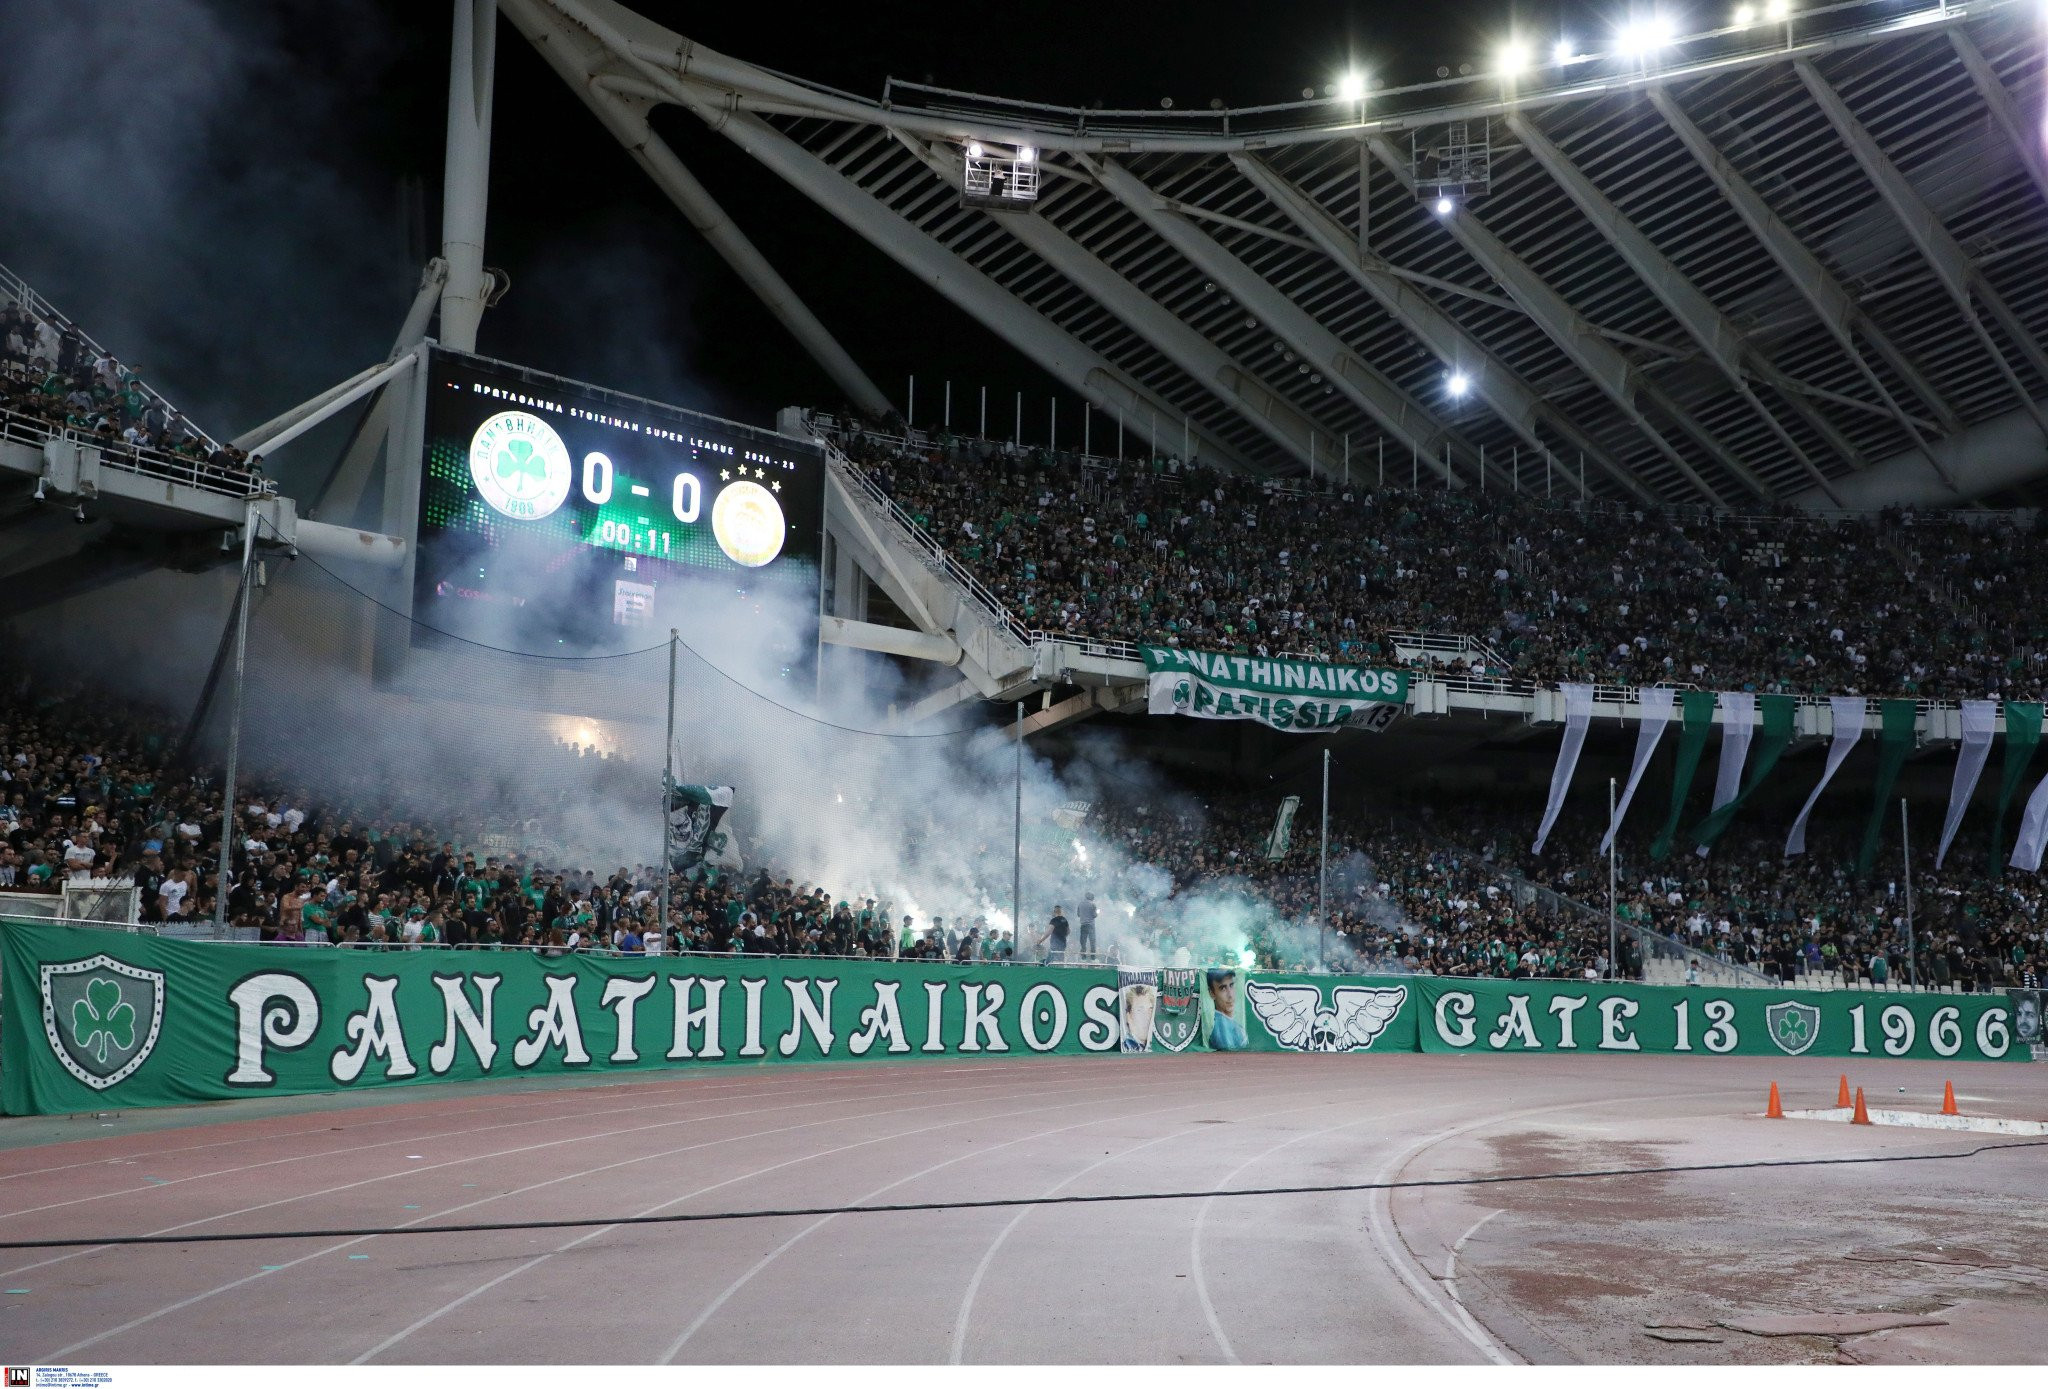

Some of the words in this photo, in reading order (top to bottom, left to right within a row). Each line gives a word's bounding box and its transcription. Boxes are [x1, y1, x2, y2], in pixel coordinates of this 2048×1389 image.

[570, 407, 639, 431] STOIXIMAN
[646, 426, 683, 443] SUPER
[690, 437, 734, 455] LEAGUE
[582, 451, 613, 505] 0
[672, 472, 701, 524] 0
[602, 520, 670, 554] 00:11
[1151, 648, 1398, 695] PANATHINAIKOS
[1367, 704, 1398, 728] 13
[226, 970, 1119, 1087] PANATHINAIKOS
[1434, 990, 1641, 1051] GATE
[1672, 998, 1740, 1055] 13
[1848, 1002, 2010, 1059] 1966
